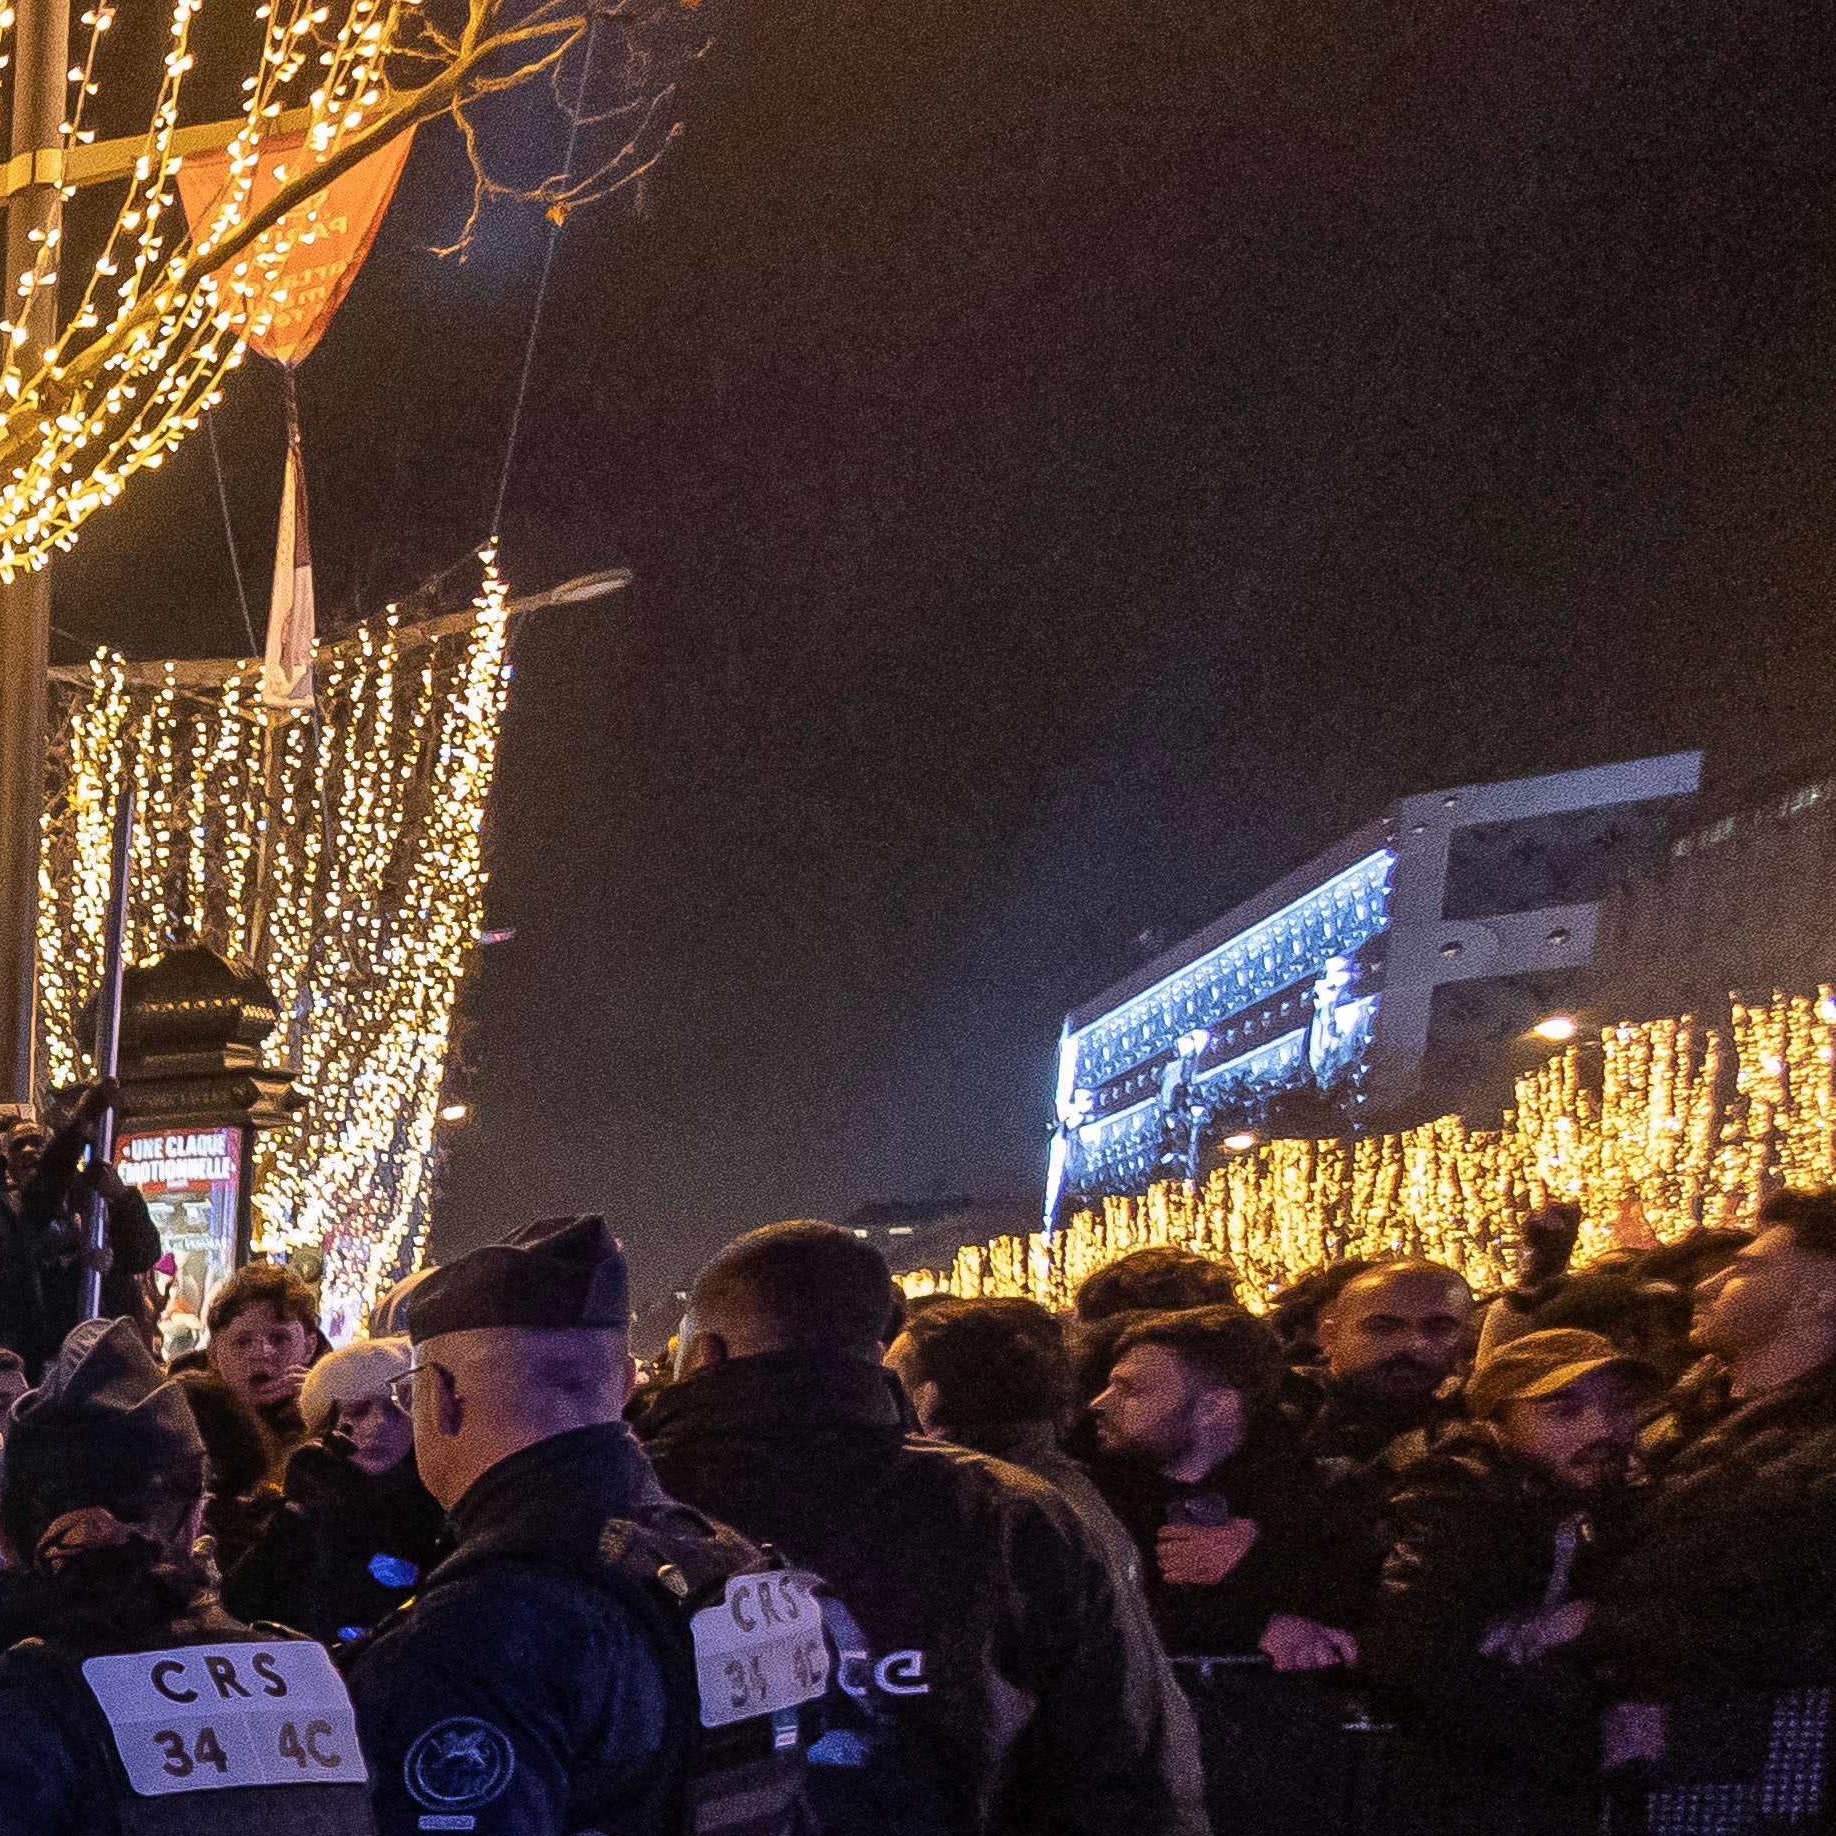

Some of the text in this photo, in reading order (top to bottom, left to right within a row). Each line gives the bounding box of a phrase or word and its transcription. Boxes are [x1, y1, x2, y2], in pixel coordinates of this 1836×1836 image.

[165, 1133, 226, 1157] CLAQUE
[730, 1576, 801, 1633] CRS
[150, 1652, 289, 1704] CRS
[152, 1719, 342, 1778] 34 4C
